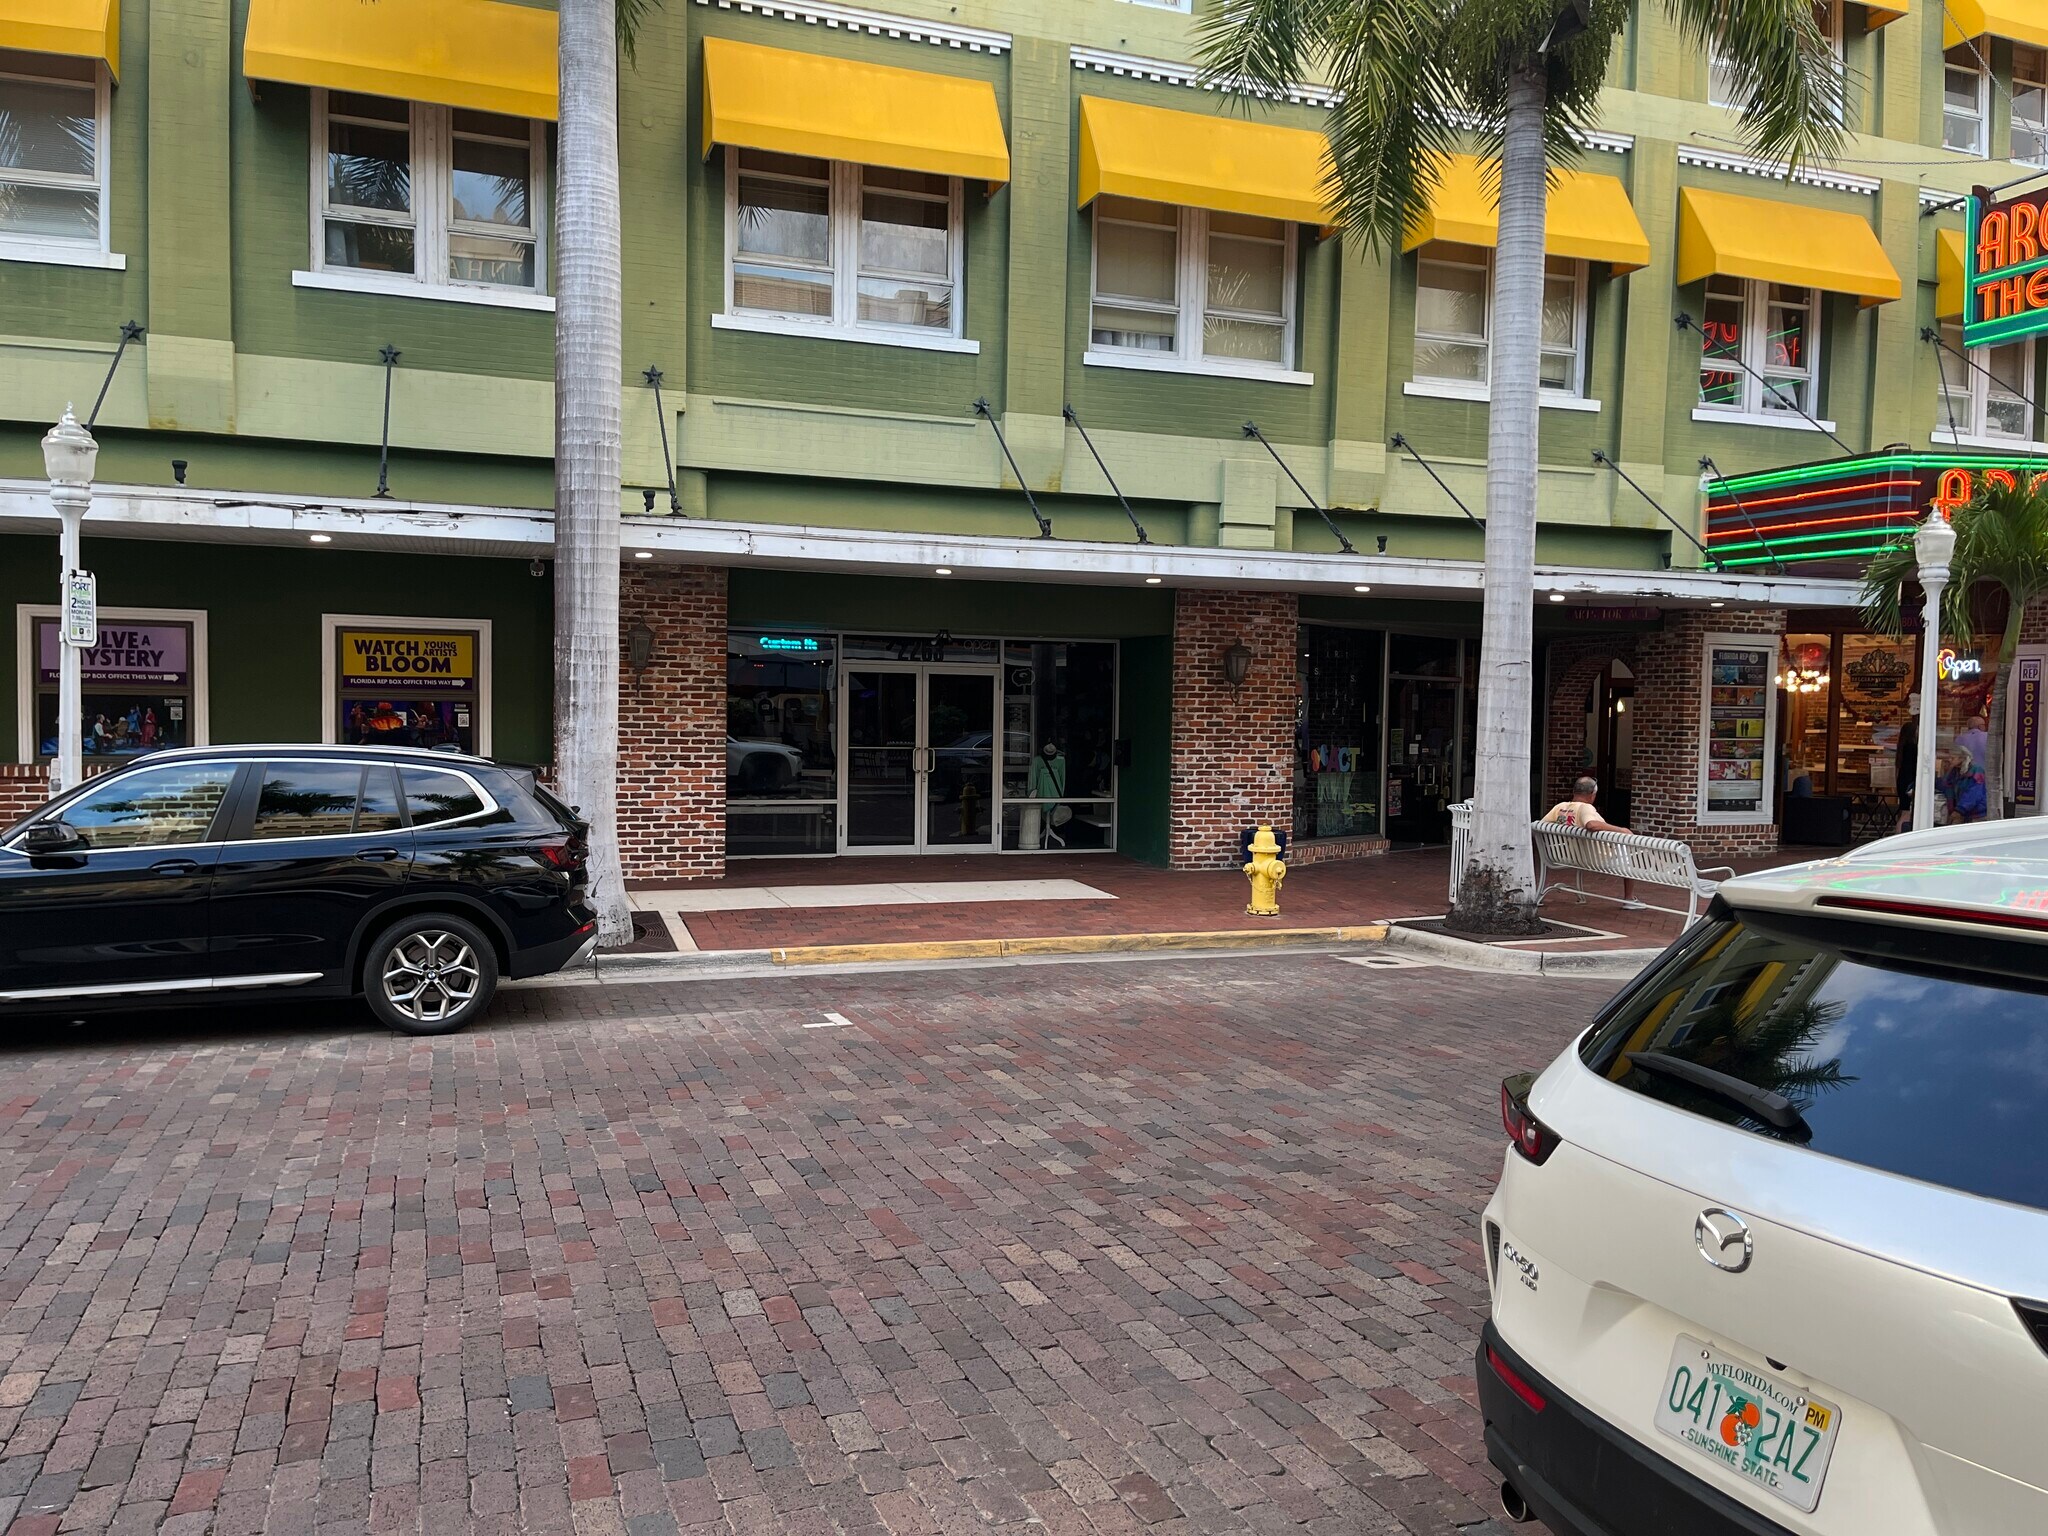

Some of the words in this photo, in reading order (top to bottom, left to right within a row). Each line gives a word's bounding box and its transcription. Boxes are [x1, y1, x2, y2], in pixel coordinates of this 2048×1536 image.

[1977, 267, 2048, 322] THE
[71, 598, 77, 608] 2
[97, 631, 139, 649] LVE
[142, 635, 151, 646] A
[354, 639, 419, 655] WATCH
[424, 641, 457, 649] YOUNG
[366, 656, 452, 673] BLOOM
[1943, 656, 1981, 680] Open
[2023, 668, 2038, 679] REP
[2024, 682, 2034, 713] BOX
[2022, 716, 2033, 778] OFFICE
[2017, 780, 2034, 788] LIVE
[1503, 1241, 1539, 1281] CX-50
[1706, 1362, 1799, 1416] MYFLORIDA.COM
[1804, 1407, 1826, 1429] PM
[1687, 1427, 1740, 1466] SUNSHINE
[1740, 1459, 1777, 1487] STATE
[1754, 1407, 1822, 1484] 2AZ
